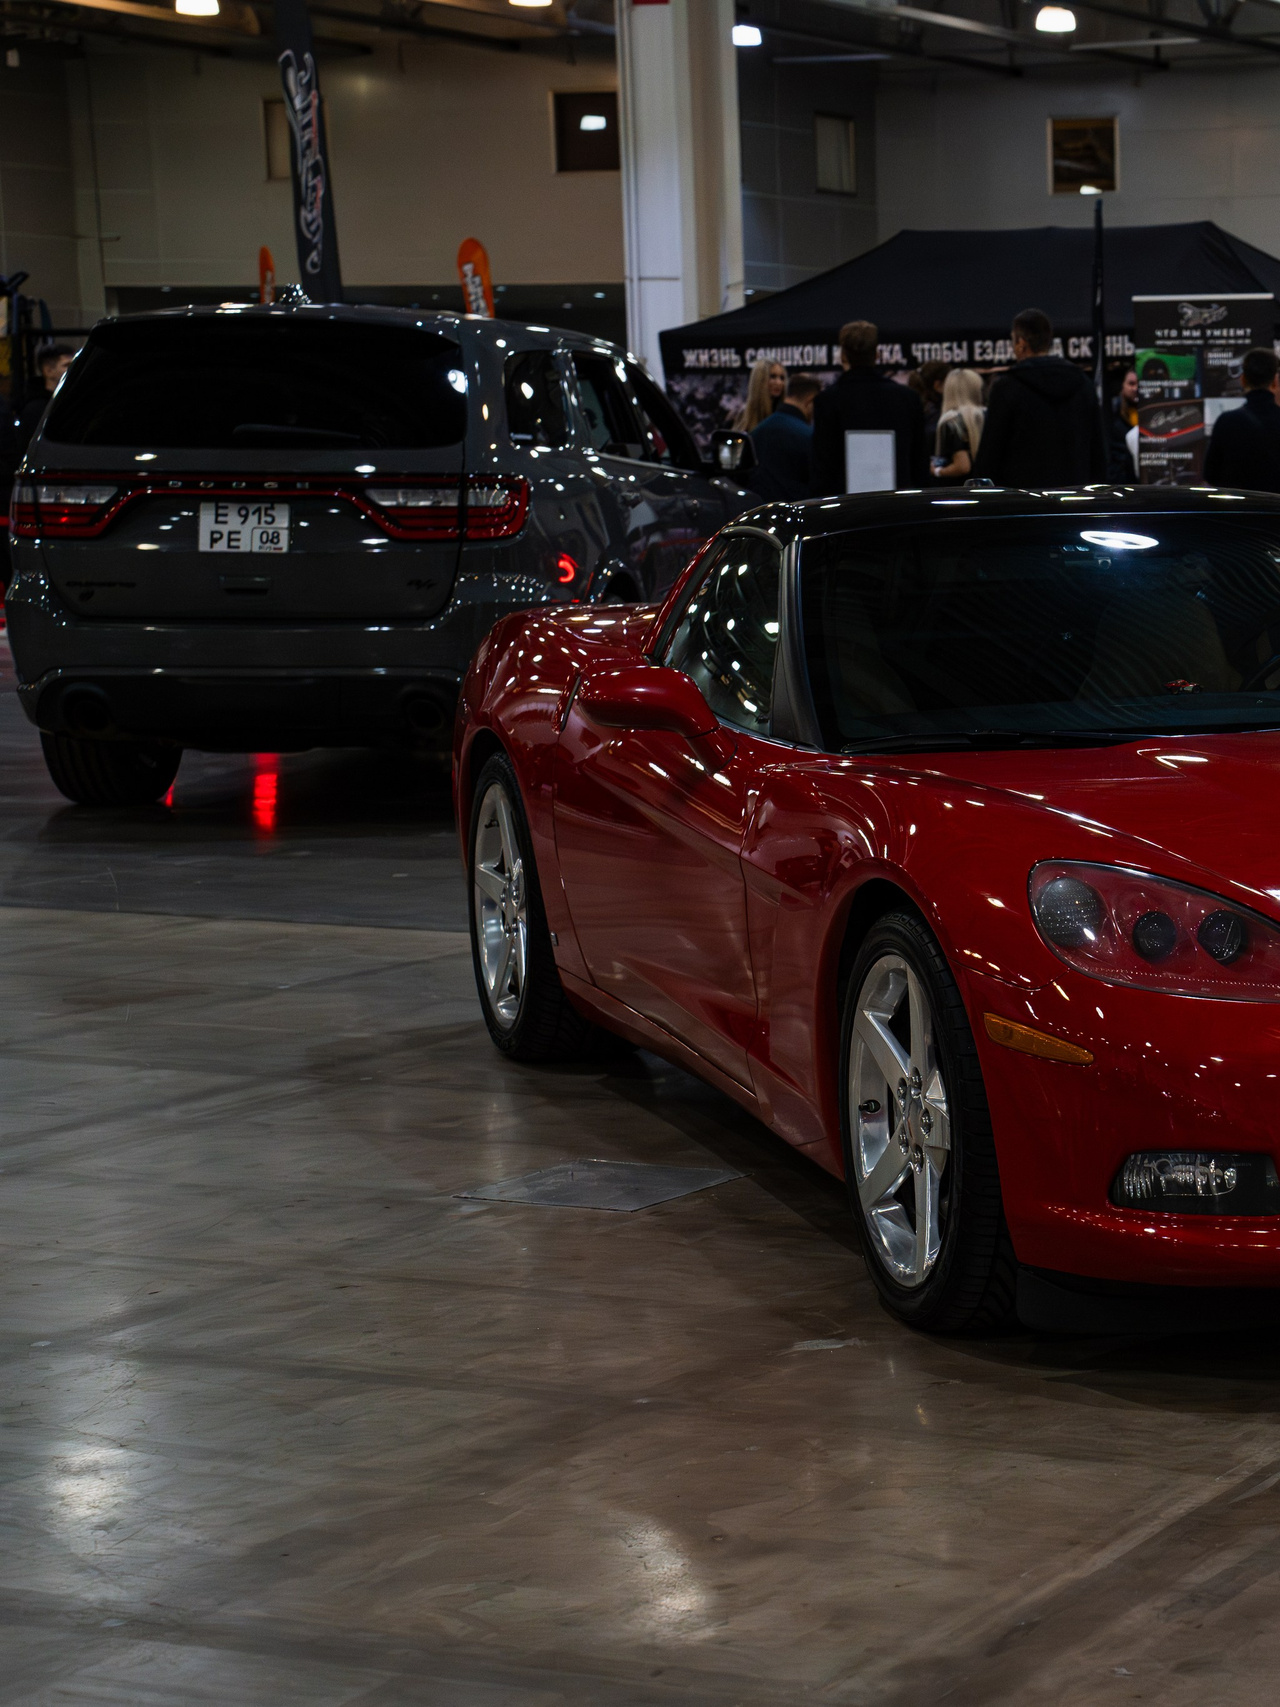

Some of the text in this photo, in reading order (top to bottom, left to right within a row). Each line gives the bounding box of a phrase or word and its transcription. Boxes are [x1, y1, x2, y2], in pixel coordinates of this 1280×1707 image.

[681, 347, 742, 369] ЖИЗНЬ
[910, 339, 969, 364] ЧТОБЫ
[237, 504, 276, 525] 915
[259, 530, 280, 544] 08
